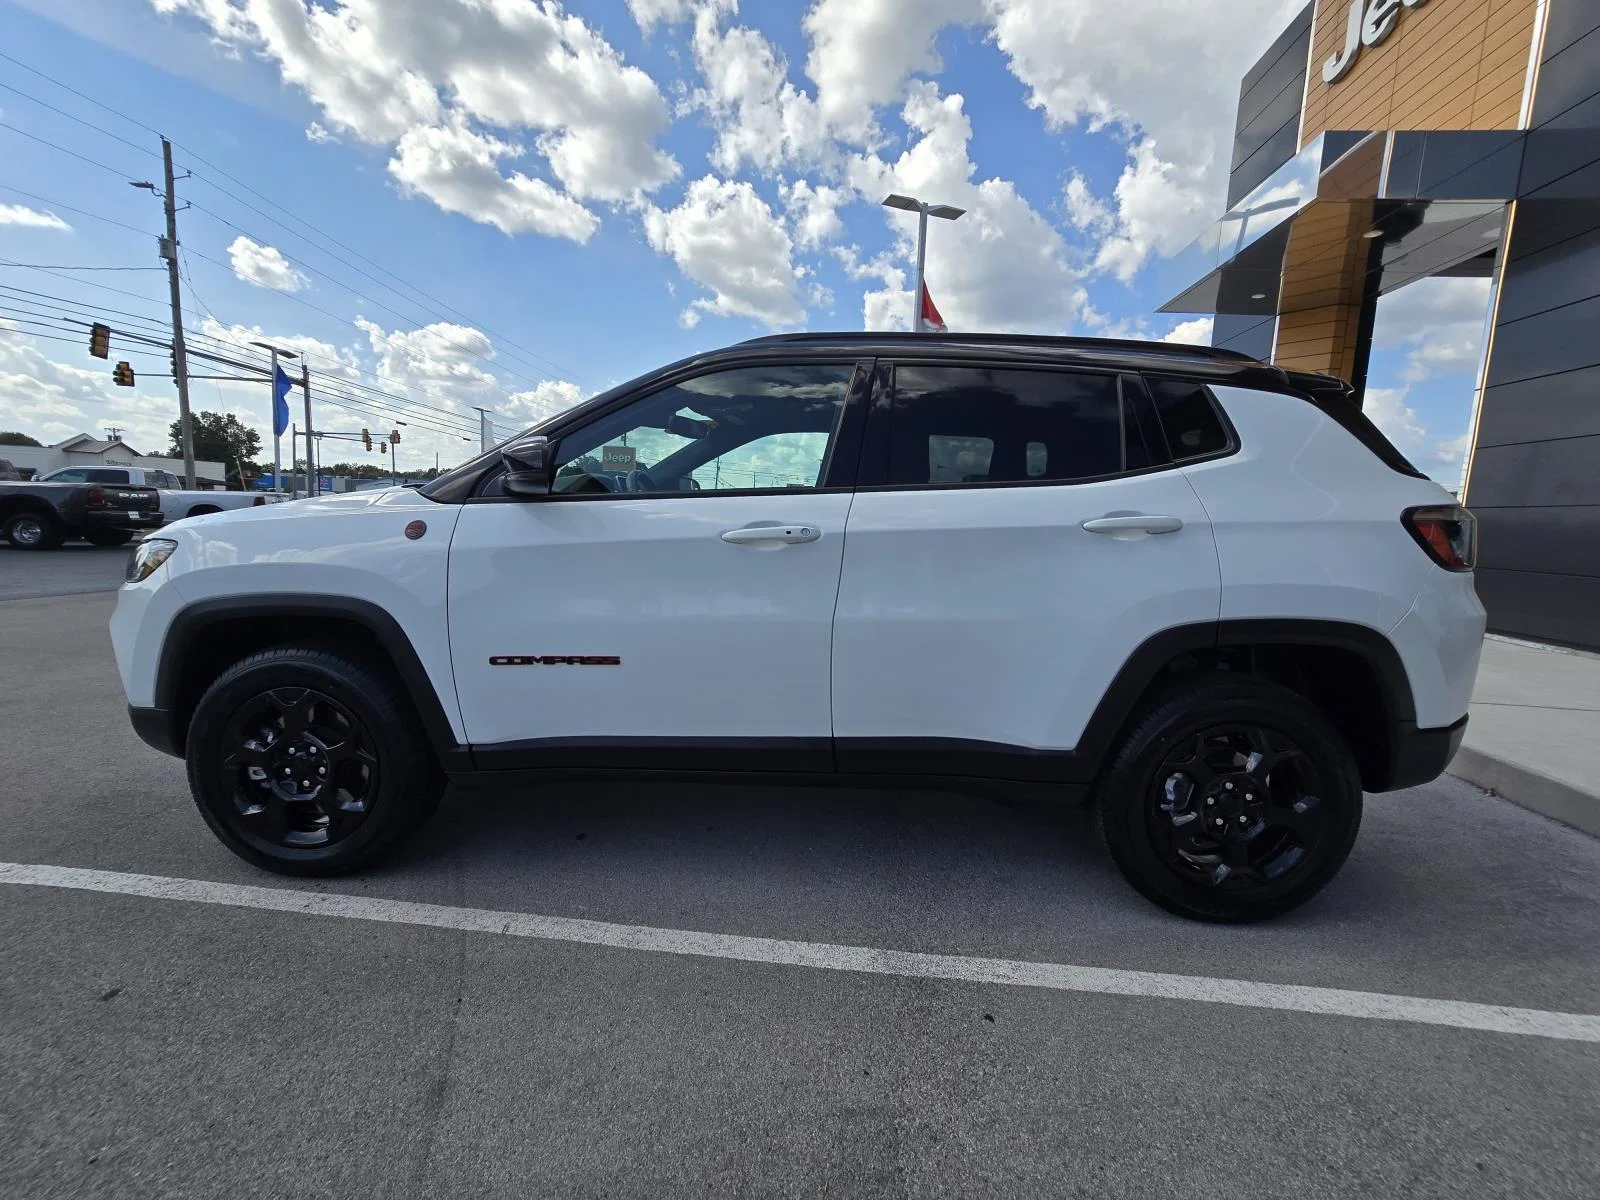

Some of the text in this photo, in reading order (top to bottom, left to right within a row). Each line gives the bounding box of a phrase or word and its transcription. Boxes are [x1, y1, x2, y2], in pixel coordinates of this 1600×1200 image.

[1322, 0, 1426, 84] Je
[604, 452, 631, 463] Jeep
[489, 655, 621, 666] COMPASS
